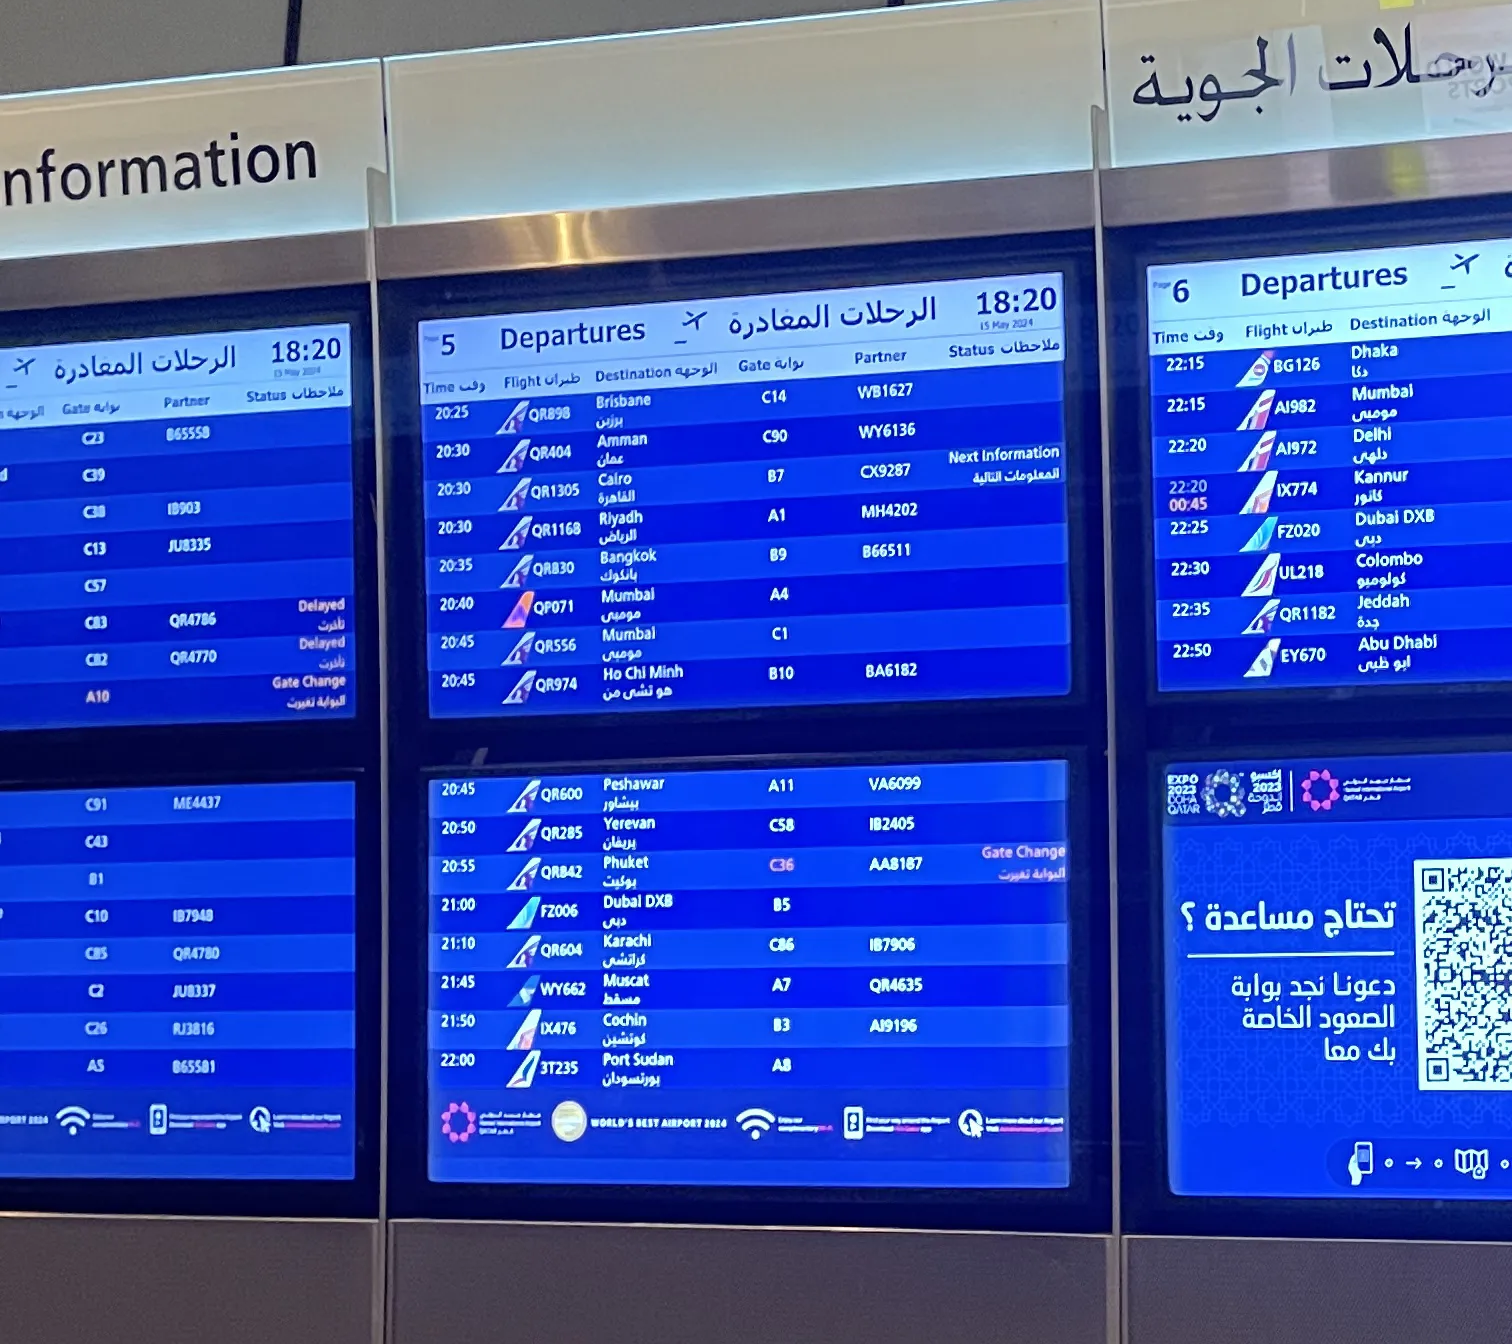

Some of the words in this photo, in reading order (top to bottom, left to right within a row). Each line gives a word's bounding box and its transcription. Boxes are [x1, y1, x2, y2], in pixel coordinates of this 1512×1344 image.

[1131, 34, 1297, 124] الجوية
[1173, 279, 1189, 303] 6
[1242, 267, 1407, 300] Departures
[977, 287, 1056, 315] 18:20
[841, 296, 935, 328] الرحلات
[729, 304, 828, 340] المغادرة
[1351, 314, 1437, 330] Destination
[501, 323, 645, 353] Departures
[1153, 332, 1188, 344] Time
[1246, 324, 1288, 339] Flight
[272, 338, 340, 363] 18:20
[442, 334, 455, 355] 5
[949, 345, 994, 357] Status
[1352, 343, 1398, 359] Dhaka
[152, 345, 235, 374] الرحلات
[855, 352, 906, 364] Partner
[1167, 356, 1204, 371] 22:15
[1274, 357, 1320, 373] BG126
[739, 360, 770, 372] Gate
[596, 368, 671, 382] Destination
[505, 376, 541, 390] Flight
[247, 391, 286, 402] Status
[762, 390, 786, 403] C14
[1353, 384, 1413, 401] Mumbai
[164, 397, 210, 408] Partner
[597, 394, 651, 408] Brisbane
[1168, 397, 1205, 412] 22:15
[1275, 399, 1316, 414] AI982
[436, 405, 468, 419] 20:25
[763, 429, 787, 443] C90
[859, 423, 915, 438] WY6136
[1354, 426, 1391, 442] Delhi
[597, 435, 647, 448] Amman
[1169, 438, 1206, 453] 22:20
[1276, 440, 1316, 456] AI972
[437, 444, 470, 458] 20:30
[530, 445, 571, 461] QR404
[949, 451, 978, 463] Next
[982, 446, 1059, 461] Information
[598, 472, 632, 486] Cairo
[768, 469, 784, 482] B7
[1355, 470, 1408, 484] Kannur
[438, 482, 471, 496] 20:30
[531, 483, 579, 499] QR1305
[1170, 480, 1207, 494] 22:20
[1277, 482, 1317, 497] IX774
[862, 503, 917, 518] MH4202
[1170, 497, 1207, 511] 00:45
[600, 510, 643, 528] Riyadh
[1356, 510, 1399, 526] Dubai
[1404, 509, 1434, 523] DXB
[1171, 520, 1208, 534] 22:25
[1278, 524, 1320, 538] FZ020
[601, 548, 656, 566] Bangkok
[1356, 551, 1423, 567] Colombo
[1172, 561, 1209, 576] 22:30
[1279, 565, 1324, 579] UL218
[299, 598, 345, 613] Delayed
[1173, 602, 1210, 616] 22:35
[1357, 594, 1409, 609] Jeddah
[1280, 606, 1335, 622] QR1182
[1358, 636, 1389, 651] Abu
[1394, 634, 1437, 649] Dhabi
[1173, 644, 1211, 658] 22:50
[1282, 648, 1325, 662] EY670
[604, 668, 622, 680] Ho
[625, 666, 646, 679] Chi
[650, 664, 683, 678] Minh
[604, 777, 664, 790] Peshawar
[769, 779, 793, 792] A11
[869, 776, 921, 790] VA6099
[1167, 774, 1199, 784] EXPO
[442, 782, 475, 796] 20:45
[541, 788, 582, 802] QR600
[1167, 785, 1197, 794] 2023
[1167, 794, 1197, 804] DOHA
[604, 817, 655, 830] Yerevan
[982, 846, 1013, 858] Gate
[1016, 845, 1066, 860] Change
[1181, 902, 1195, 931] ؟
[1206, 901, 1313, 930] مساعدة
[1324, 899, 1396, 938] تحتاج
[604, 934, 651, 947] Karachi
[604, 974, 649, 987] Muscat
[870, 978, 922, 993] QR4635
[1232, 973, 1281, 1002] بوابة
[1290, 976, 1323, 1000] نجد
[1334, 972, 1395, 1001] دعونا
[540, 982, 585, 996] WY662
[603, 1013, 647, 1026] Cochin
[1241, 1005, 1312, 1030] الخاصة
[1320, 1004, 1394, 1034] الصعود
[1325, 1037, 1360, 1060] معا
[1368, 1037, 1395, 1065] بك
[603, 1053, 630, 1066] Port
[633, 1052, 673, 1066] Sudan
[541, 1061, 578, 1074] 3T235
[661, 1119, 702, 1128] AIRPORT
